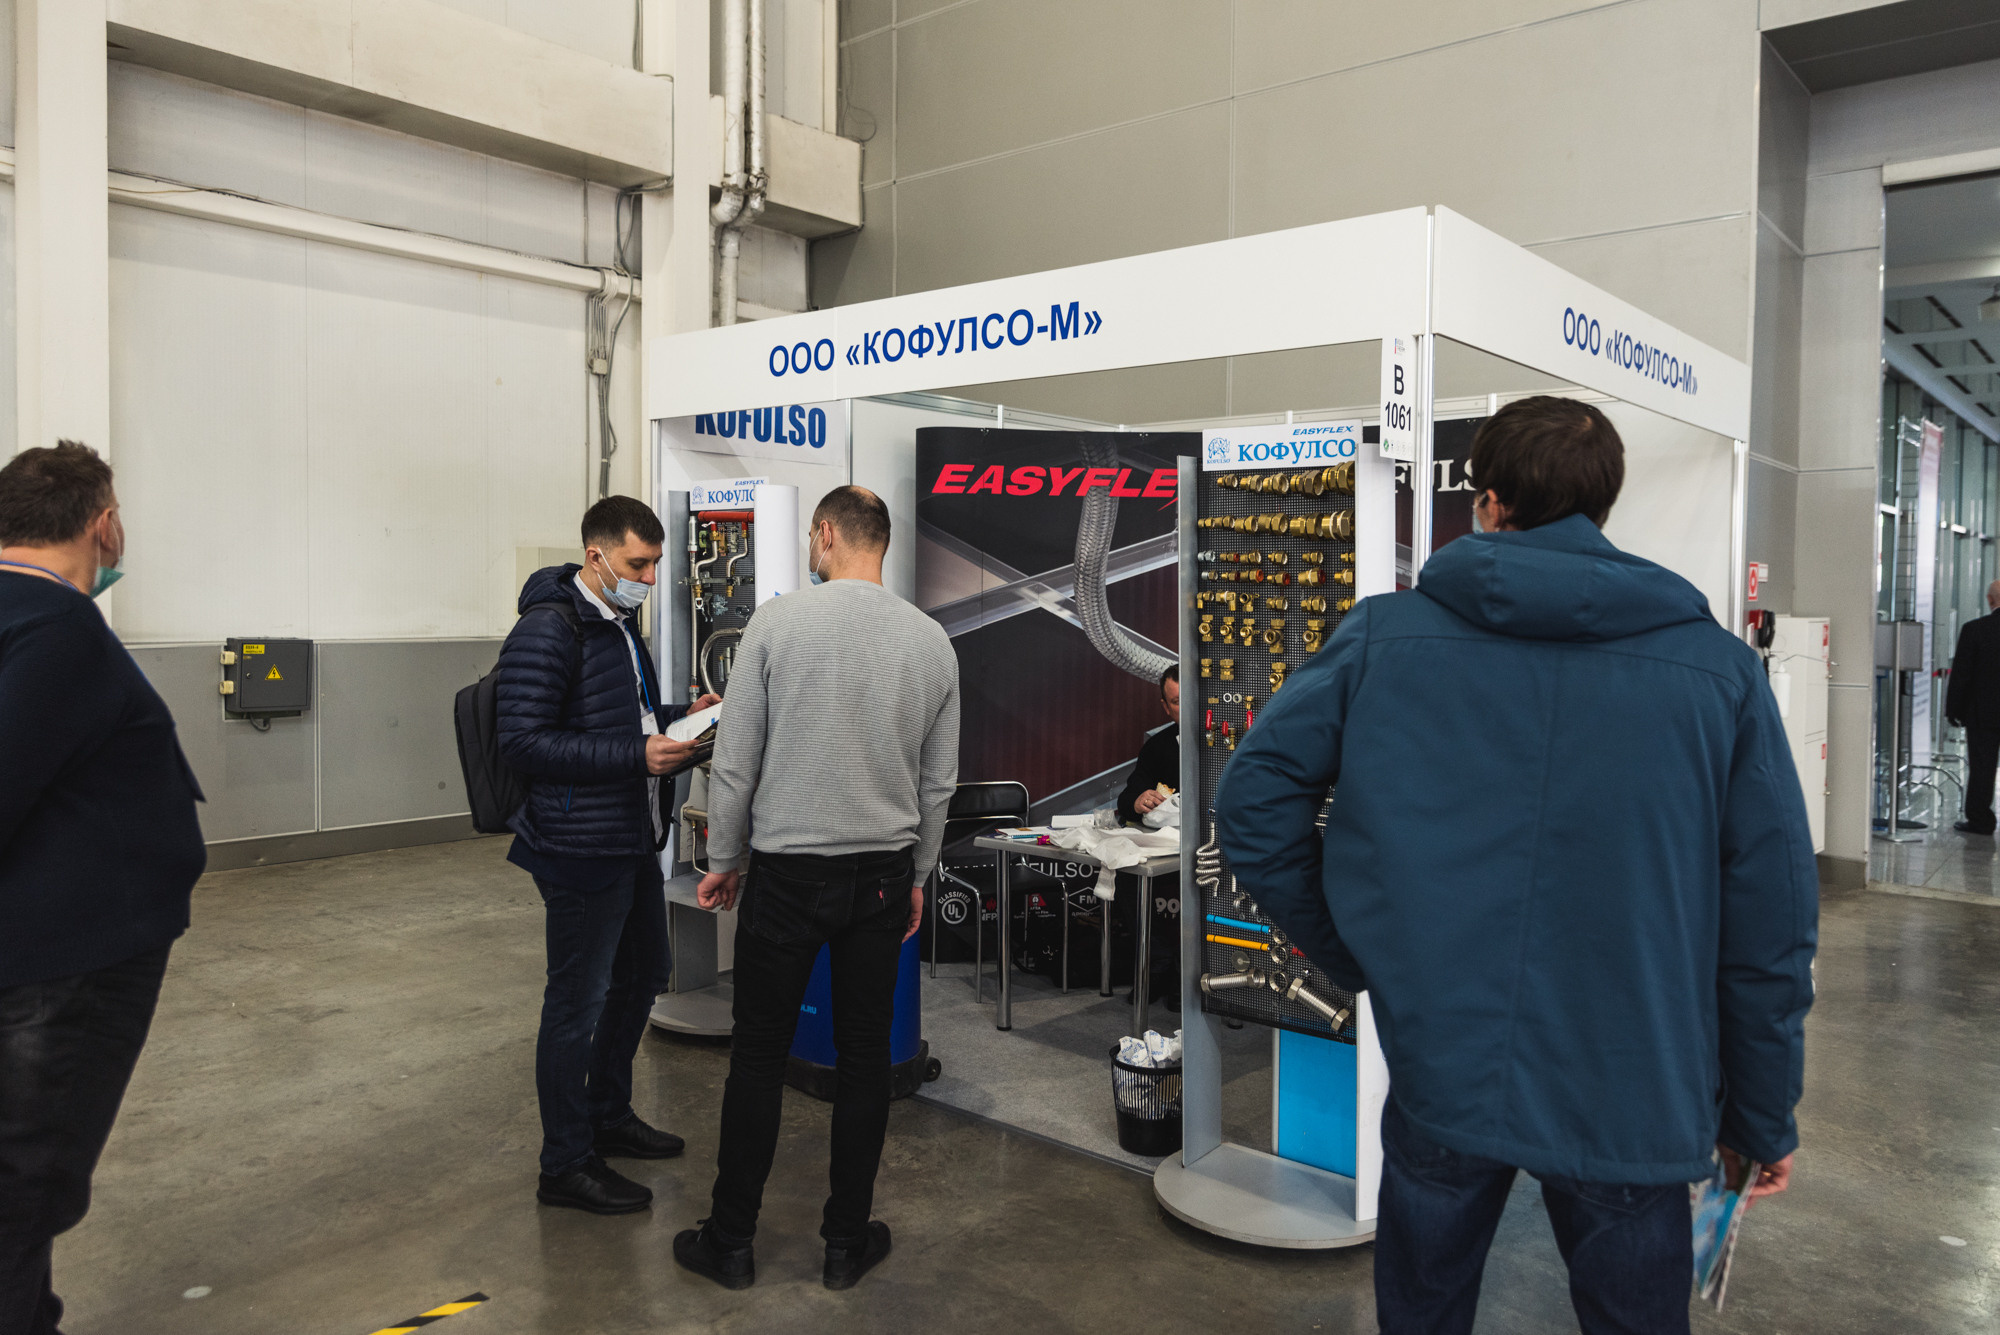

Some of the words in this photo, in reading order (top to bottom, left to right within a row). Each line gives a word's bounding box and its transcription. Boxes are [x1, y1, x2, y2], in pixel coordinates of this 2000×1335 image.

[769, 338, 835, 377] ООО
[845, 301, 1103, 366] «КОФУЛСО-М»
[1563, 307, 1600, 356] ООО
[1606, 329, 1698, 395] «КОФУЛСО-М»
[1394, 364, 1404, 395] B
[1385, 401, 1411, 431] 1061
[1293, 426, 1354, 436] EASYFLEX
[1237, 438, 1356, 464] КОФУЛСО
[937, 891, 971, 905] CLASSIFIED
[948, 904, 962, 918] UL
[1079, 895, 1097, 904] FM
